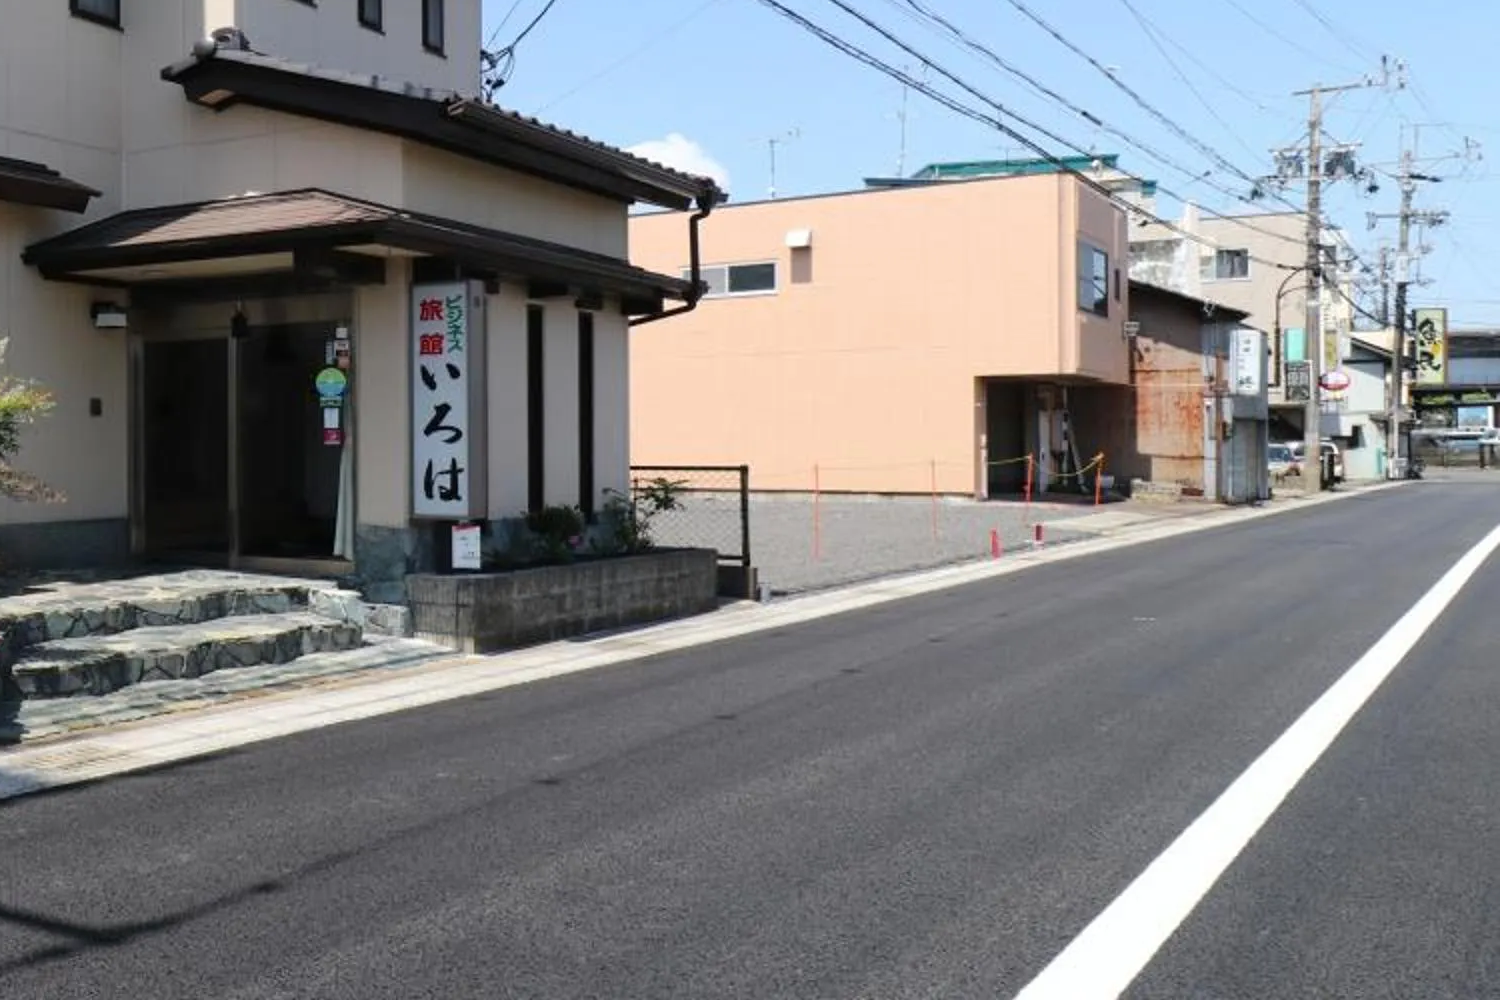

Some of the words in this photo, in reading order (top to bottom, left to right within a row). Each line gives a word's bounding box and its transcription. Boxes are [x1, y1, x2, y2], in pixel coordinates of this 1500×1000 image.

[419, 298, 444, 355] 旅館
[446, 295, 463, 353] ビジネス
[419, 363, 464, 501] いろは
